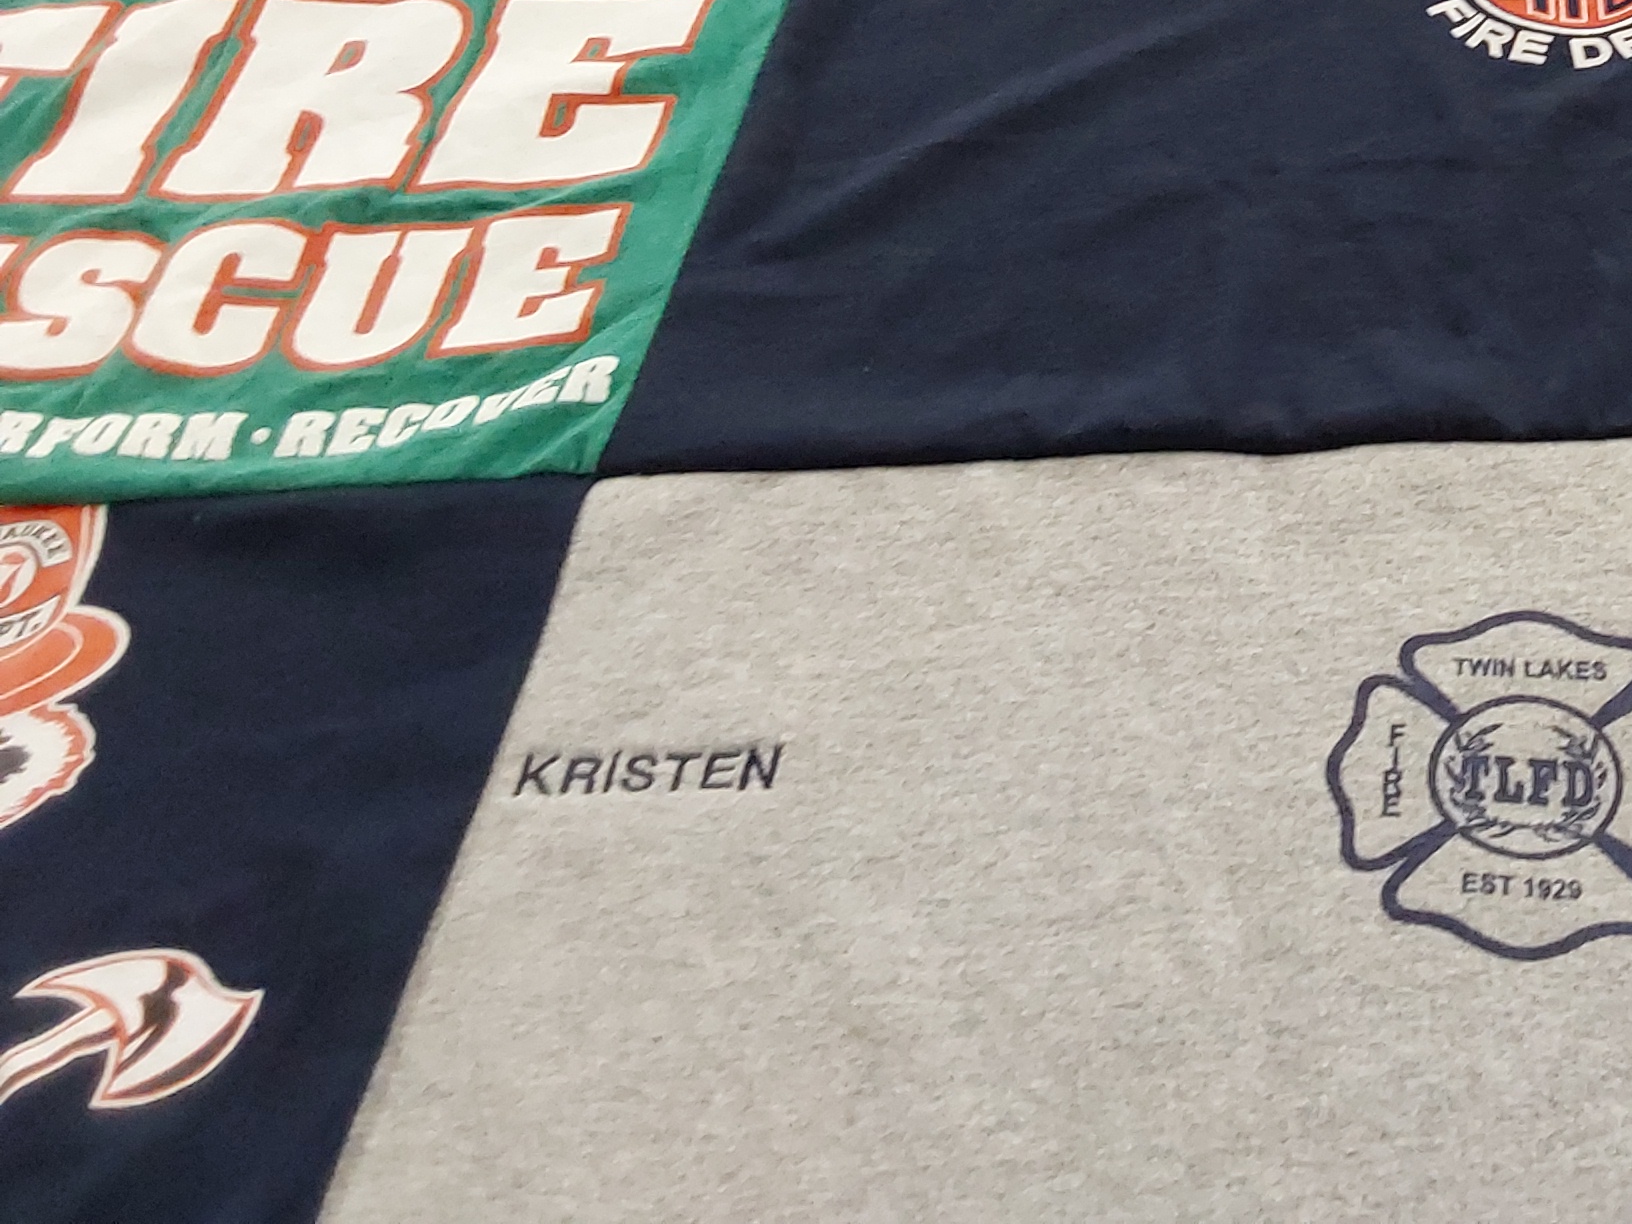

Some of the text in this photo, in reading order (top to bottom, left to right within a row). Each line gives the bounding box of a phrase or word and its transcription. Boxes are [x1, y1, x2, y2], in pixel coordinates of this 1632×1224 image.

[273, 354, 621, 461] RECOVER
[1453, 657, 1609, 681] TWIN LAKES
[512, 742, 786, 797] KRISTEN
[1381, 723, 1408, 818] FIRE
[1462, 755, 1597, 807] TLFD
[1461, 872, 1584, 901] EST 1929
